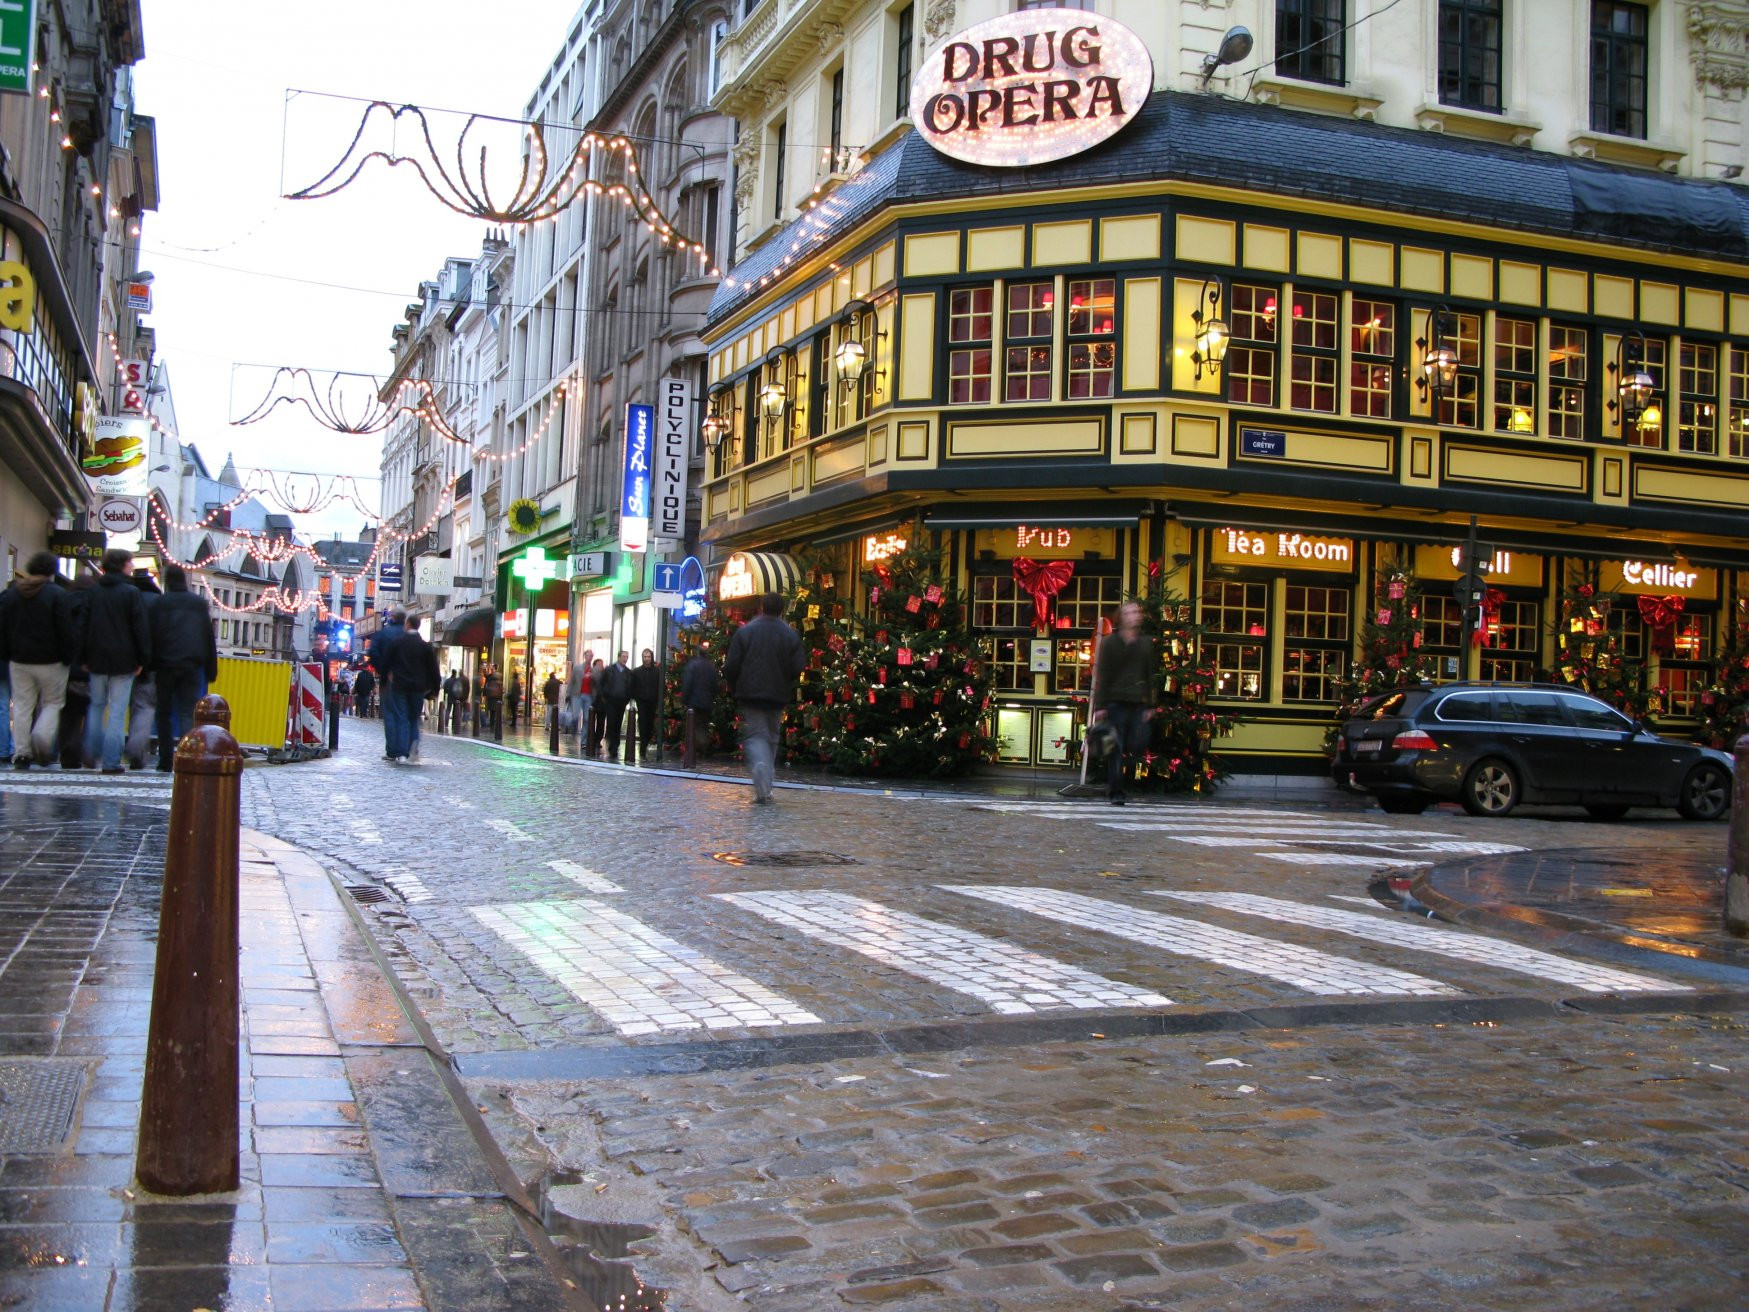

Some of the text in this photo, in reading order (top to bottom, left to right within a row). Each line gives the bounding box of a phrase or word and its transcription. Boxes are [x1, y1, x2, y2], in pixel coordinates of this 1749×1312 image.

[942, 25, 1102, 82] DRUG
[923, 75, 1128, 135] OPERA
[628, 410, 648, 517] Sun Planet
[662, 382, 685, 534] POLYCLINIQUE
[103, 509, 135, 521] Sebahat
[1017, 526, 1071, 548] Pub
[1221, 527, 1348, 561] Tea Room
[1622, 560, 1697, 588] Cellier
